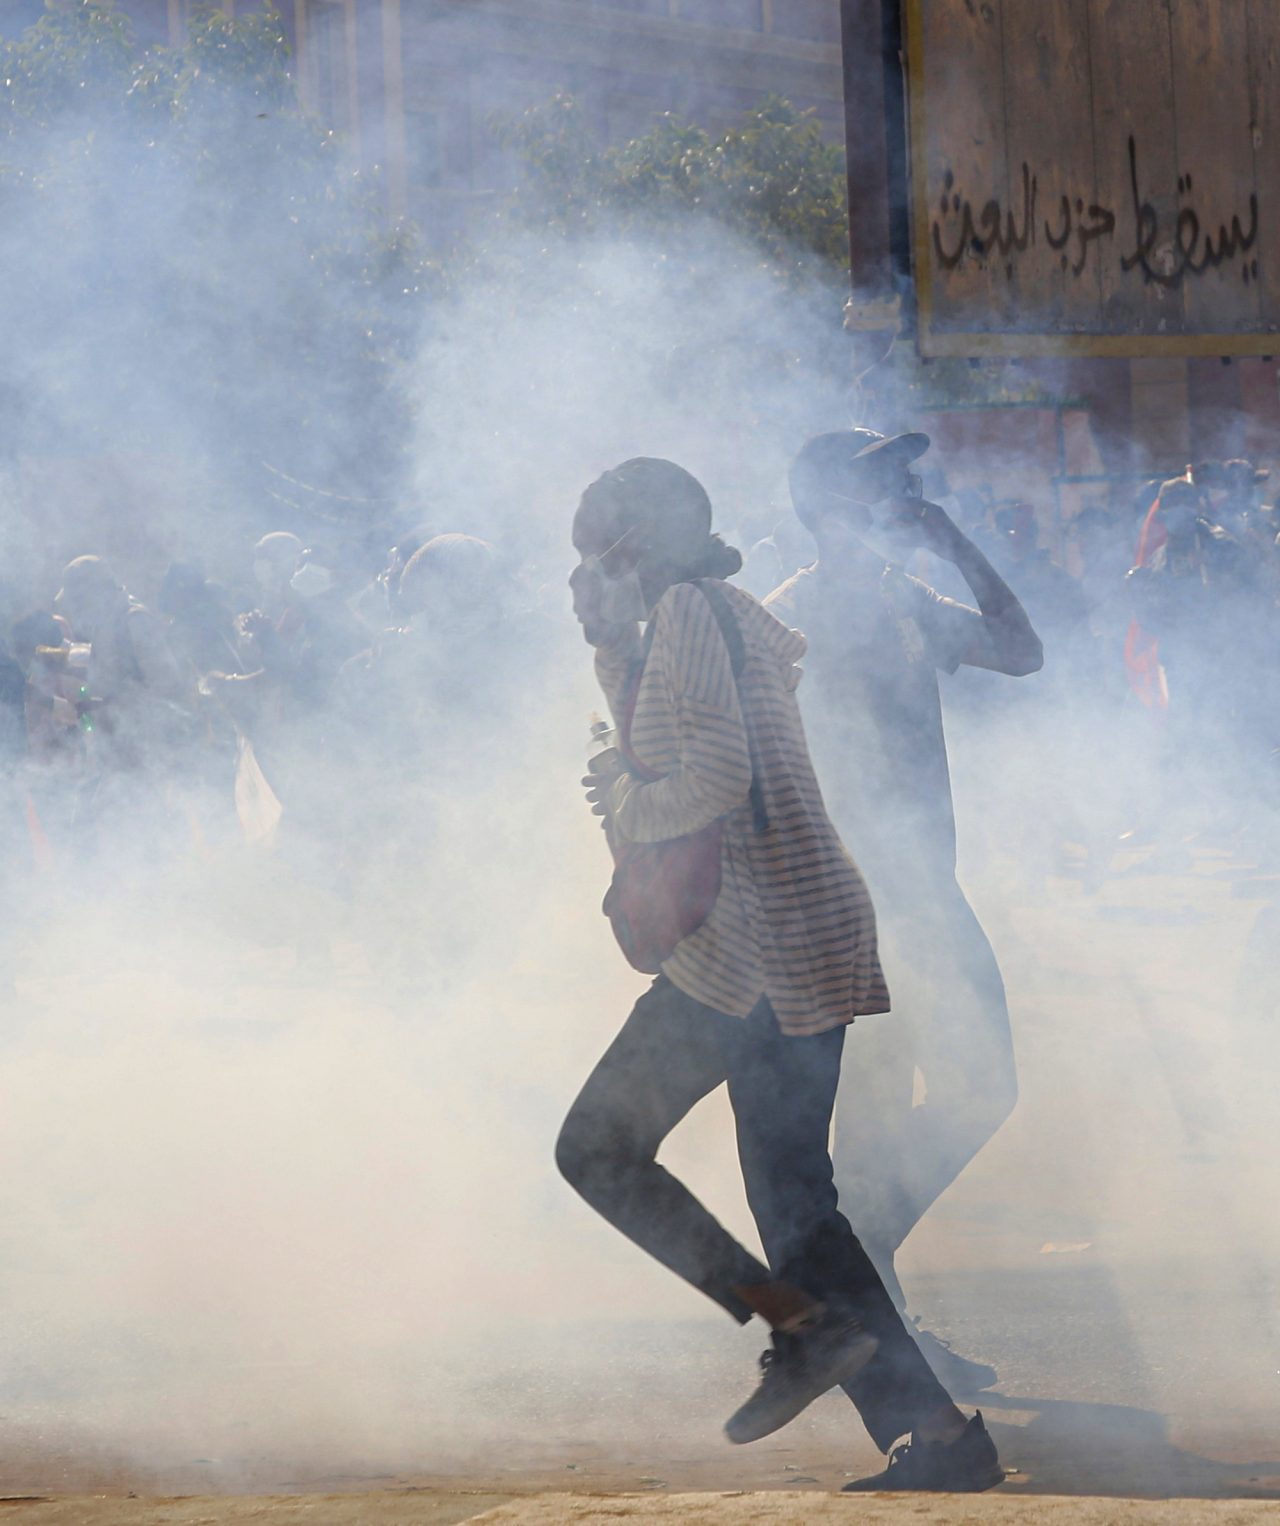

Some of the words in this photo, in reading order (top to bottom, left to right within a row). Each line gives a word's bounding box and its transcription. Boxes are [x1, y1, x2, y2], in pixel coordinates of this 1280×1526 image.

[932, 160, 1038, 280] البعث
[1045, 194, 1116, 278] حزب
[1121, 134, 1259, 289] يسقط
